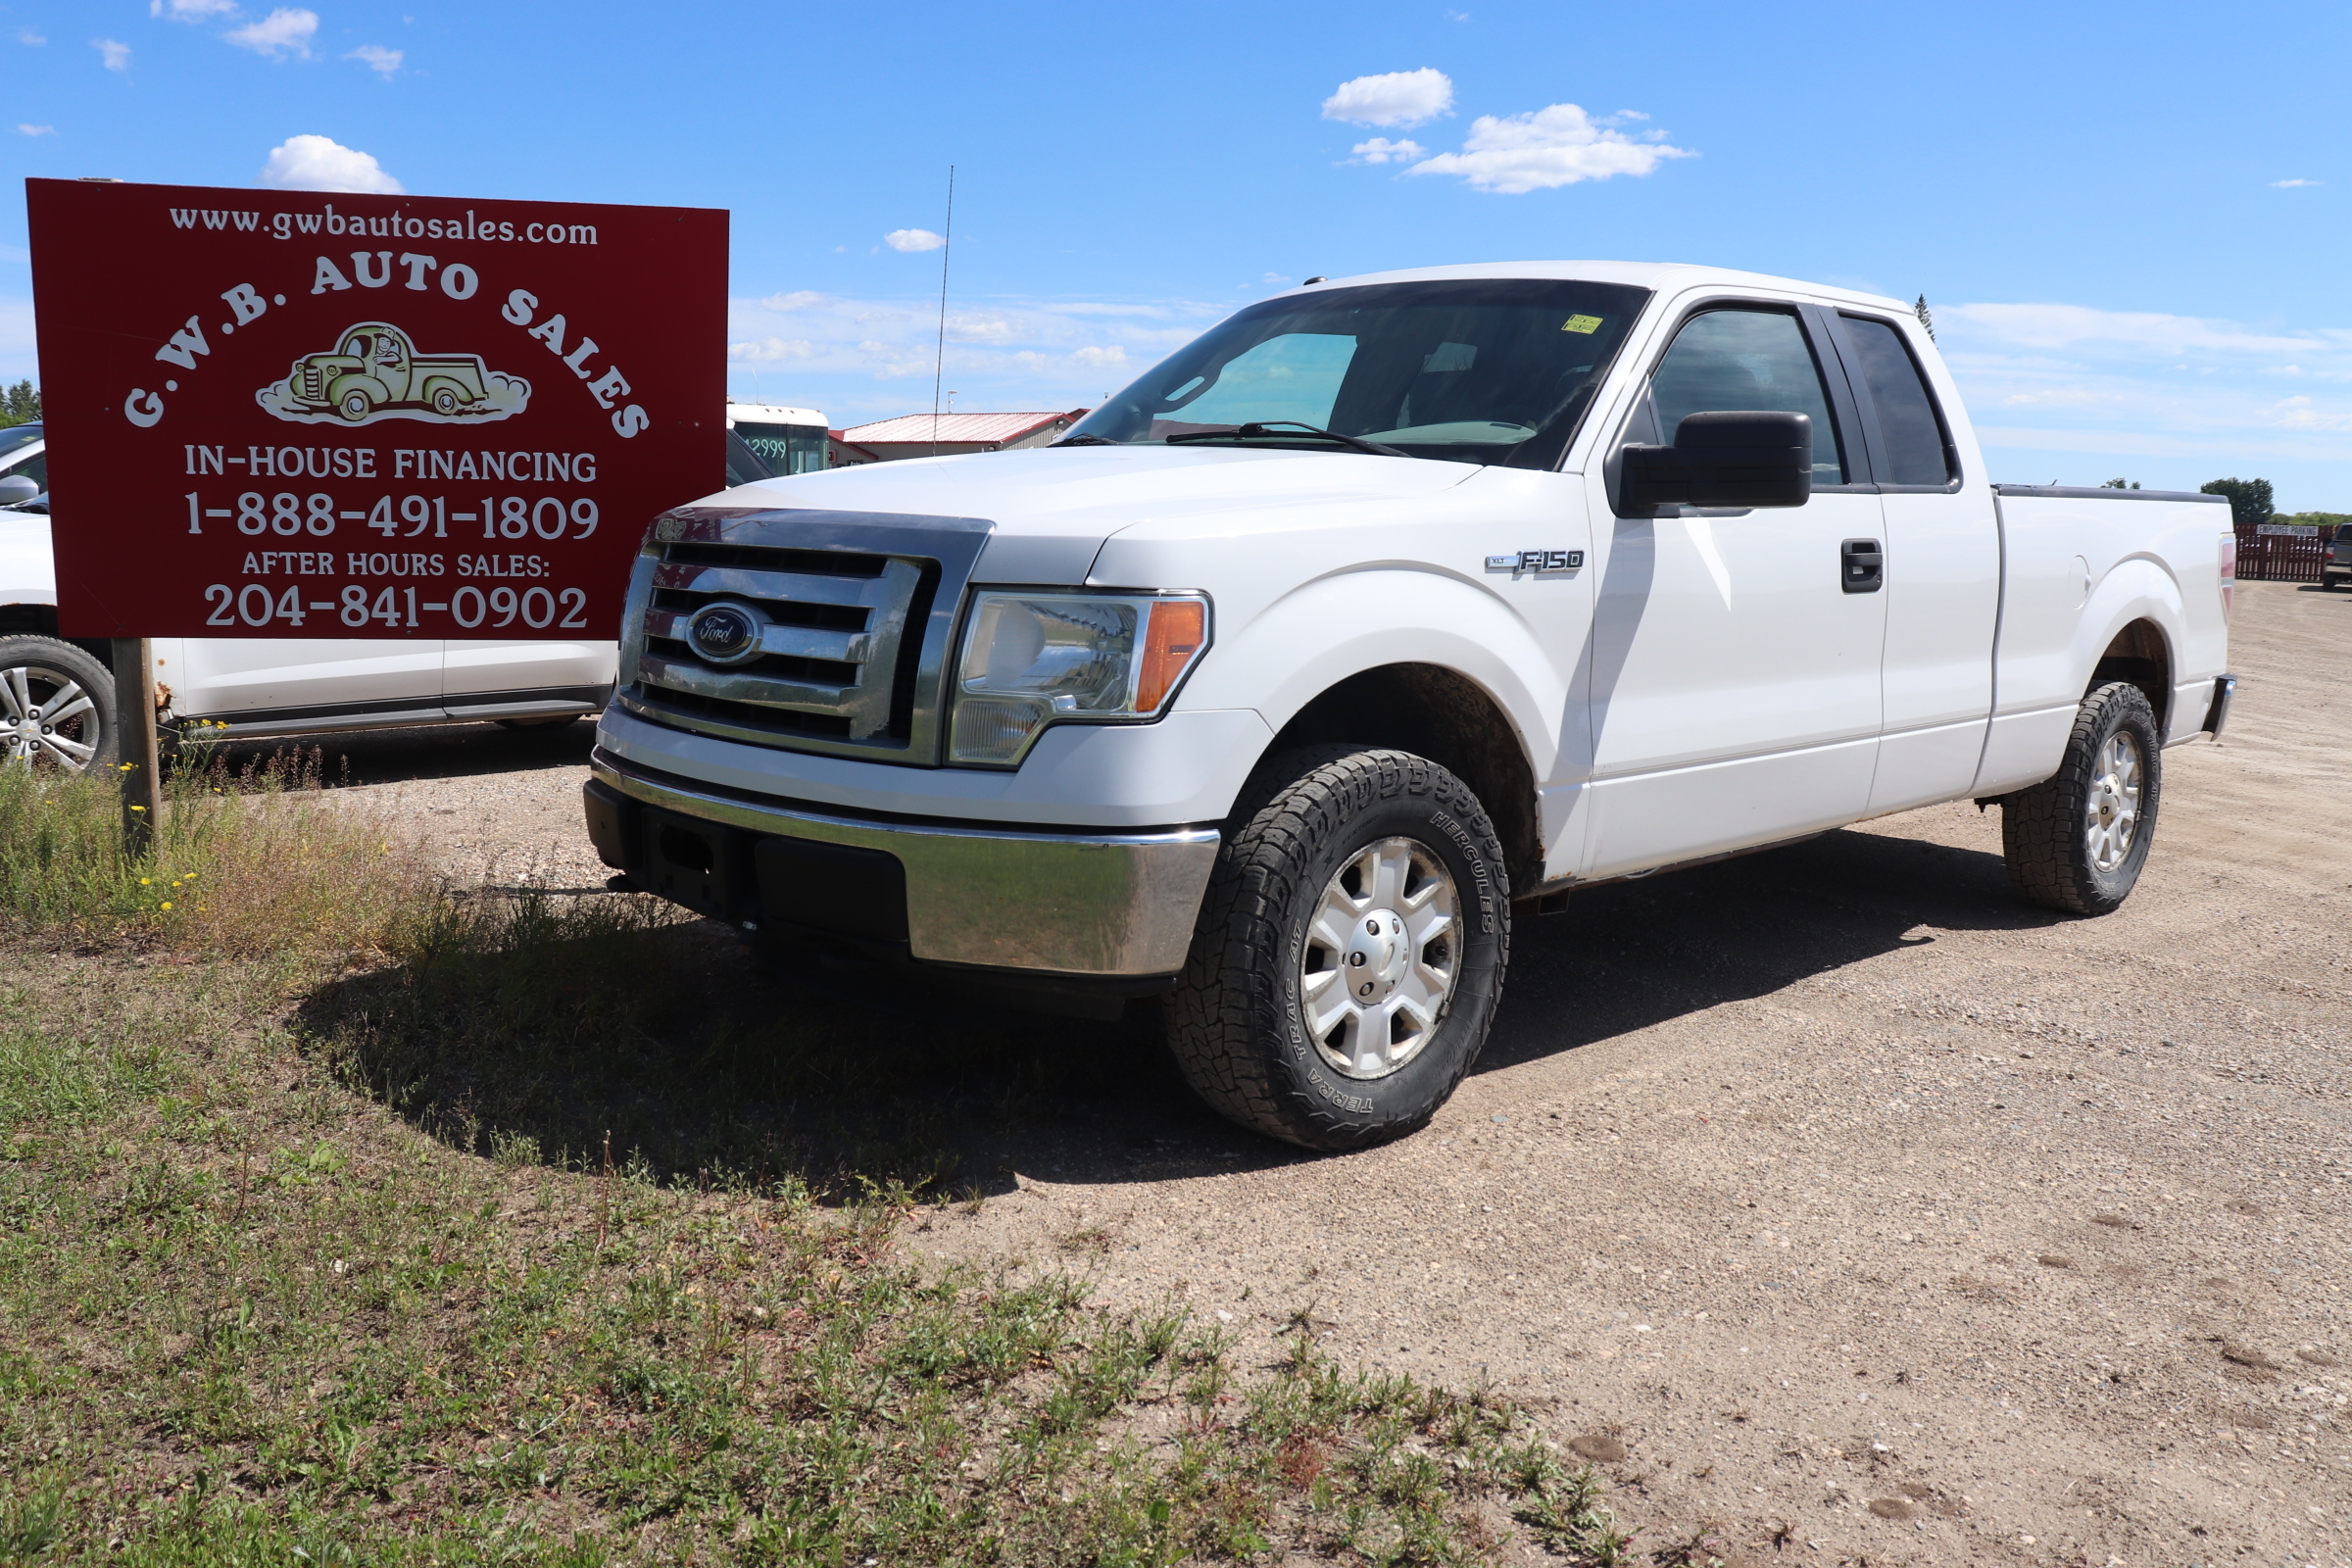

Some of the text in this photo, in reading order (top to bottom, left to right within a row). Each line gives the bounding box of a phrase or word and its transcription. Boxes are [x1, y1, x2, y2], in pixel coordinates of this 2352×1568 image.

[170, 204, 598, 244] www.gwbautosales.com
[310, 252, 479, 301] AUTO
[501, 288, 650, 439] SALES
[184, 444, 598, 483] IN-HOUSE FINANCING
[184, 491, 599, 541] 1-888-491-1809
[2258, 524, 2317, 536] EMPLOYEE PARKING
[241, 551, 551, 577] AFTER HOURS SALES:
[1518, 549, 1585, 571] F-150
[204, 583, 588, 629] 204-841-0902
[700, 615, 734, 643] Ford
[1430, 810, 1494, 934] HERCULES
[1285, 918, 1374, 1115] TERRA TRAC AT
